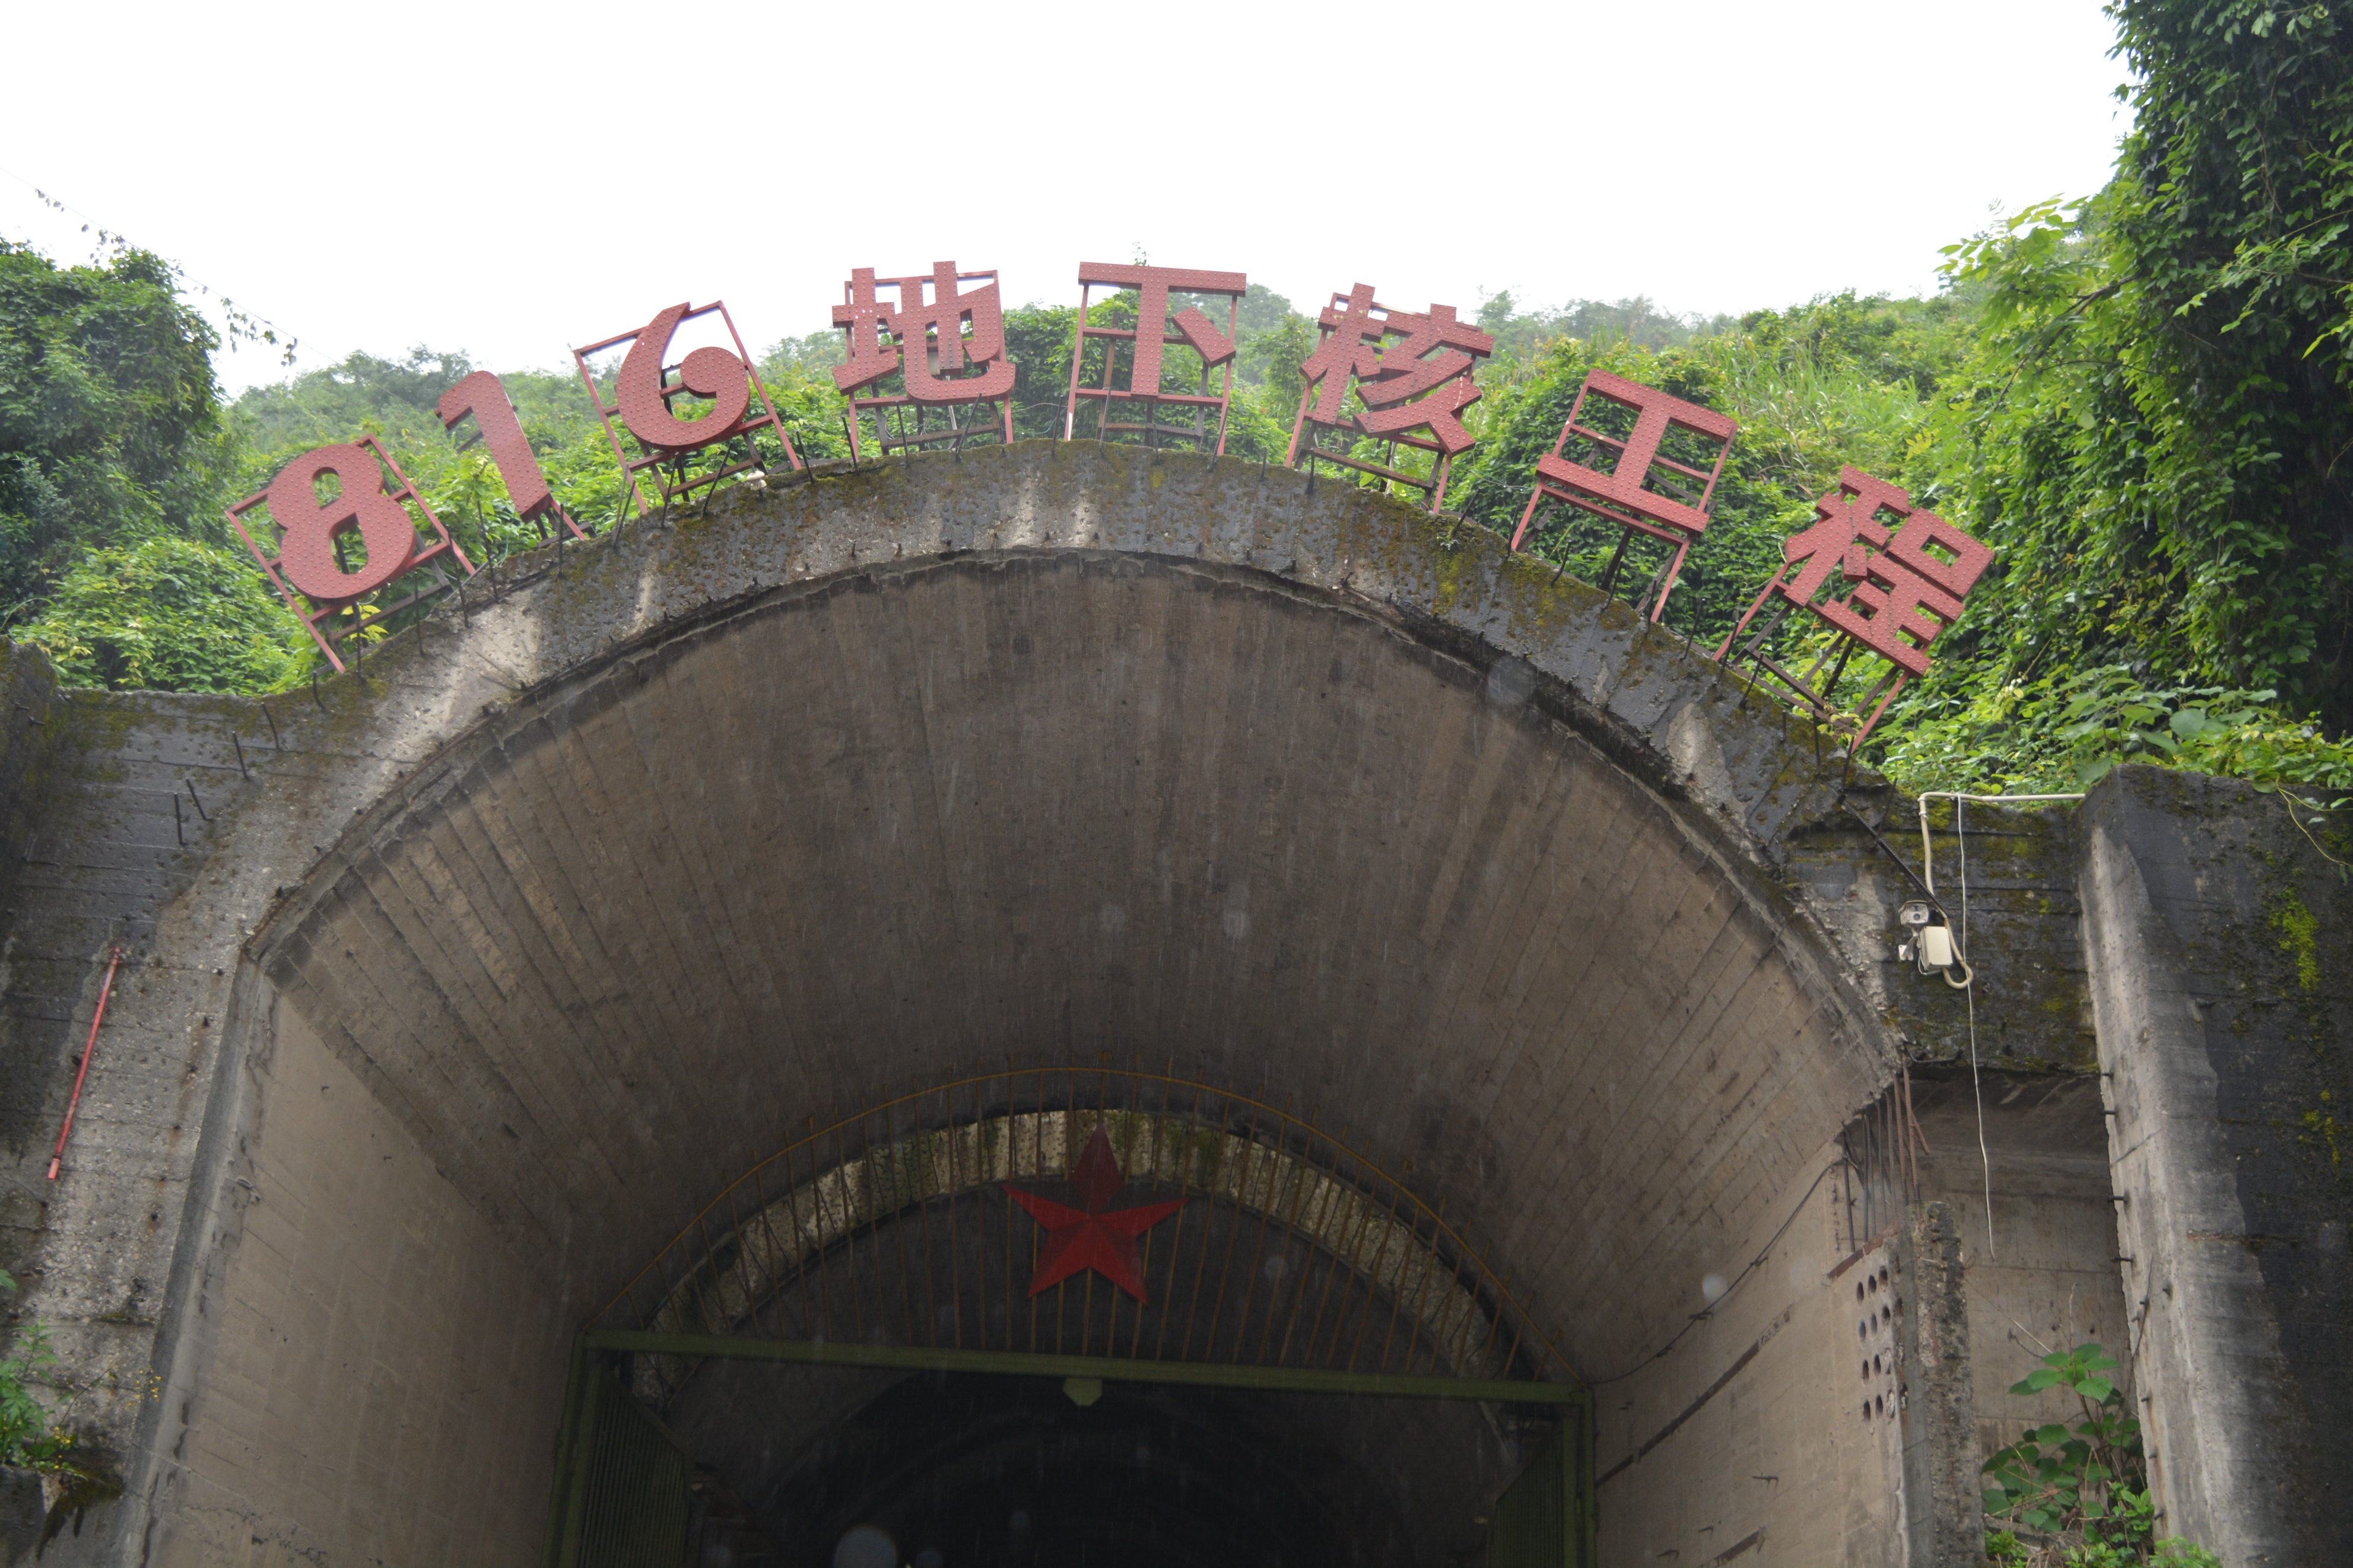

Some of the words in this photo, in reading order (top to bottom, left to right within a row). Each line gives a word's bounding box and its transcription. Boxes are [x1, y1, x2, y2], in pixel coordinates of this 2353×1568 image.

[266, 261, 1995, 678] 816地下核工程
